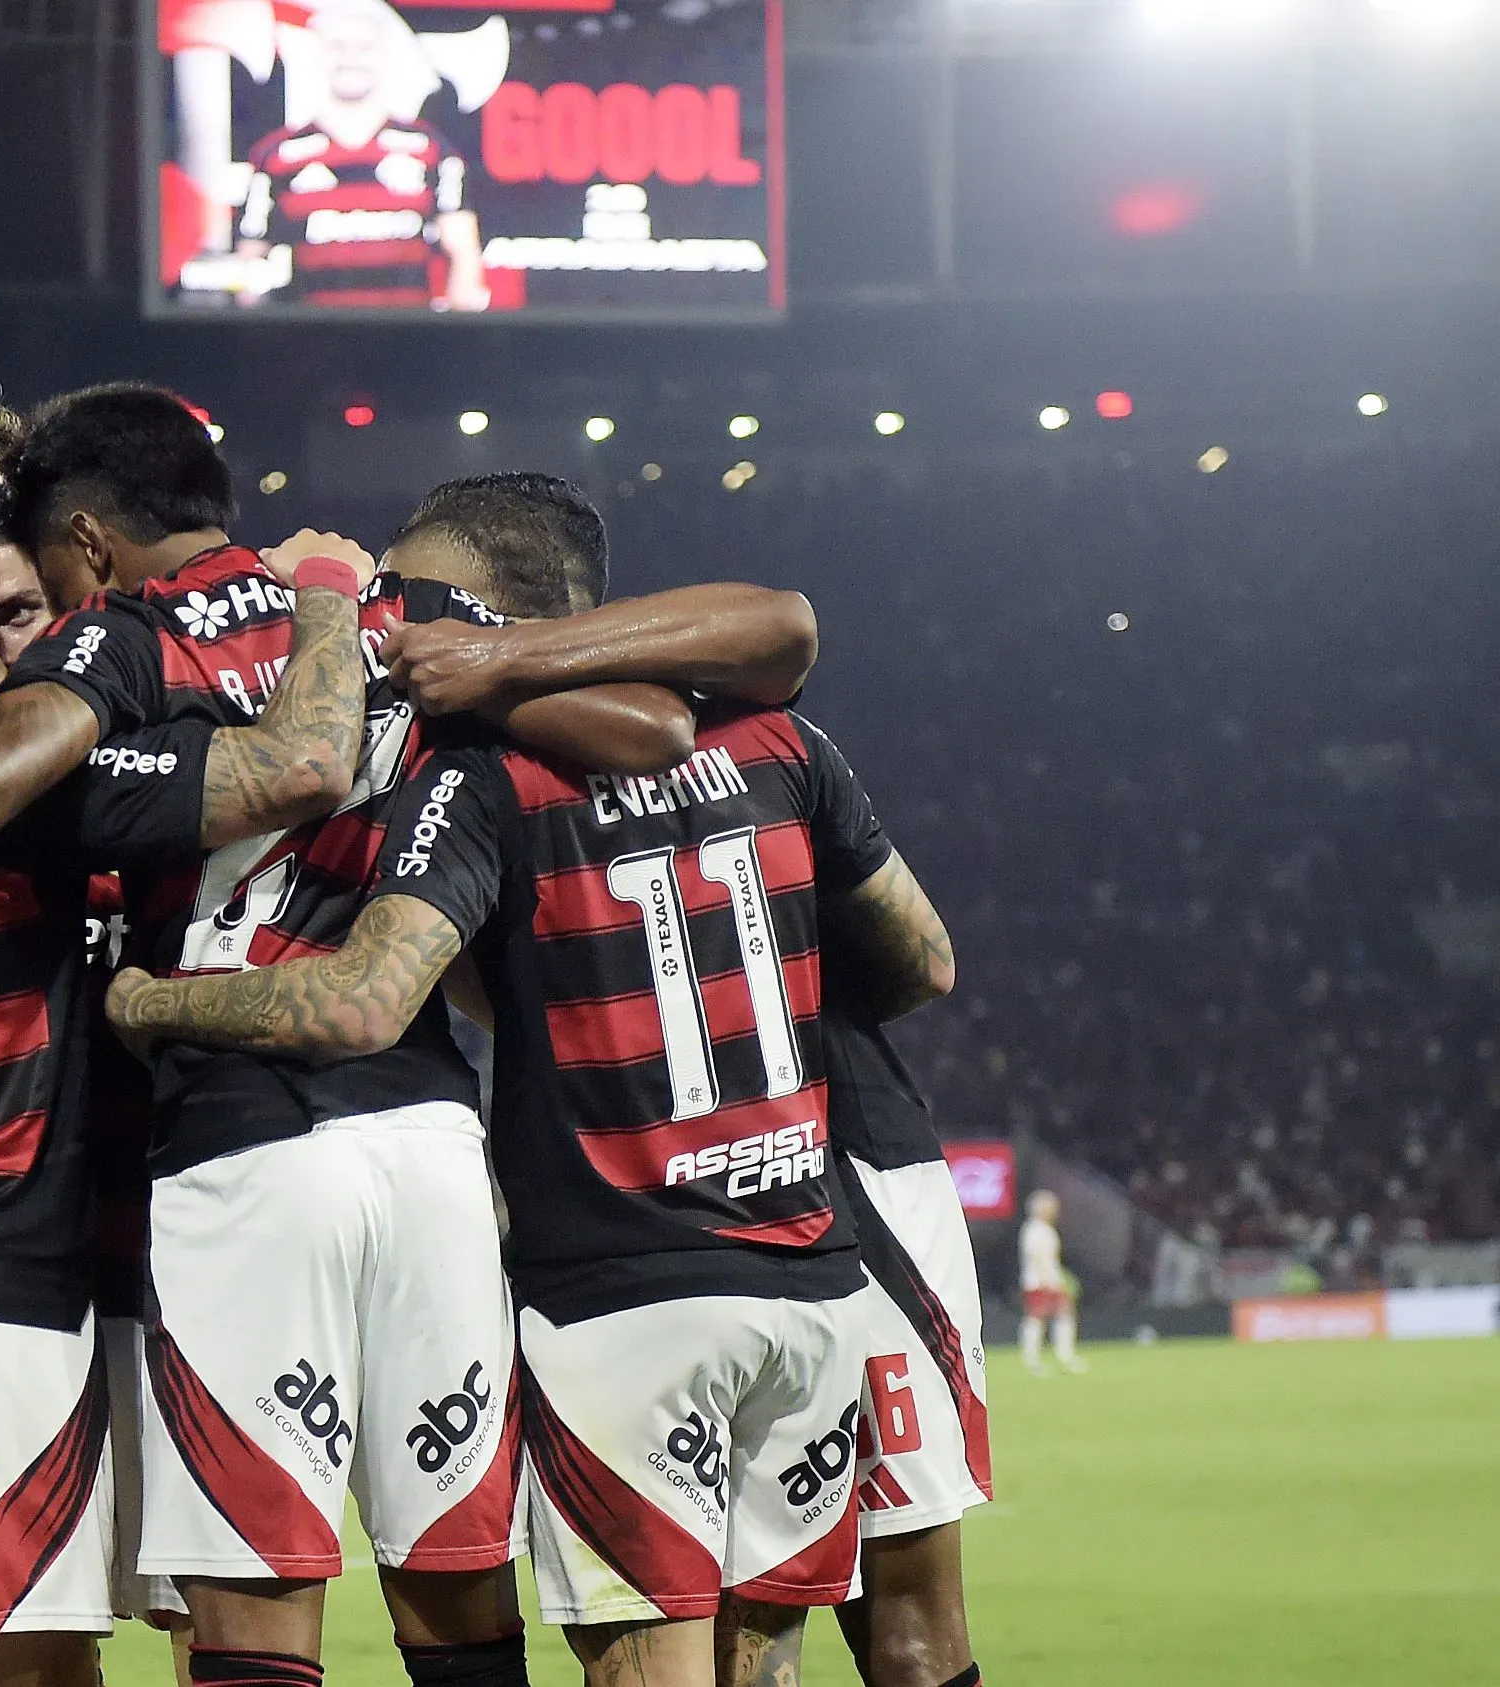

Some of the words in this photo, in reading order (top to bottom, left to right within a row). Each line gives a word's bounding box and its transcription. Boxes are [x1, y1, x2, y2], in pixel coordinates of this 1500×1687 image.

[481, 81, 761, 186] GOOOL
[88, 747, 178, 777] opee
[396, 769, 465, 877] Shopee
[650, 878, 673, 953] TEXACO
[734, 858, 758, 932] TEXACO
[607, 825, 804, 1123] 11
[665, 1119, 818, 1187] ASSIST
[726, 1147, 825, 1199] CARD
[255, 1396, 276, 1416] da
[275, 1415, 333, 1485] construção
[274, 1358, 352, 1469] abc
[406, 1360, 491, 1473] abc
[436, 1473, 456, 1492] da
[648, 1452, 668, 1471] da
[666, 1469, 723, 1531] construção
[802, 1507, 822, 1525] da
